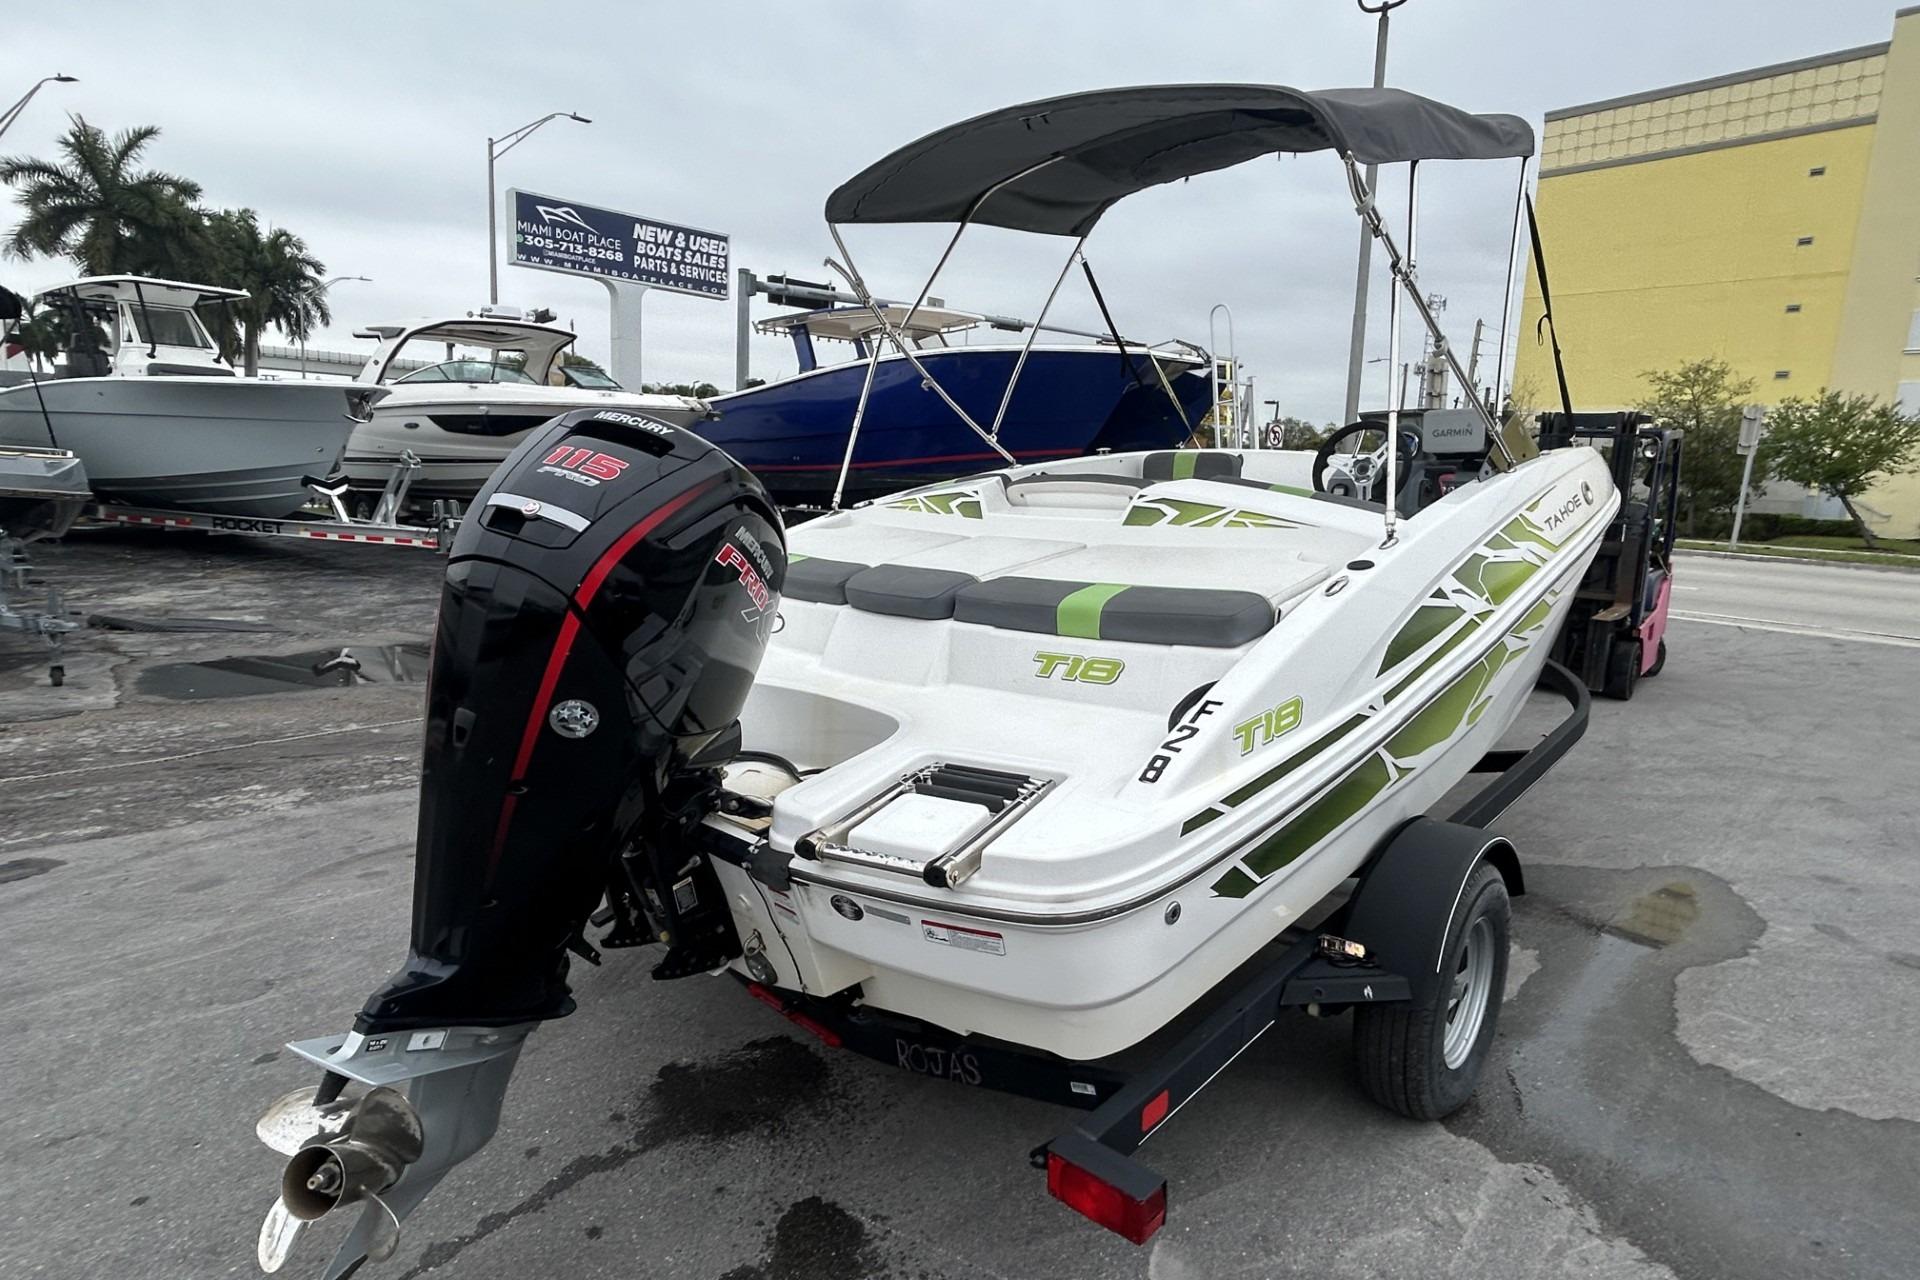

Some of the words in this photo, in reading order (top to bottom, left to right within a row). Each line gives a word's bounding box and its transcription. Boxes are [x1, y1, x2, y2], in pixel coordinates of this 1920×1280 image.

[517, 220, 552, 237] MIAMI
[555, 227, 584, 243] BOAT
[587, 234, 621, 250] PLACE
[524, 235, 624, 262] 305-713-8268
[633, 223, 673, 245] NEW
[675, 232, 686, 248] &
[689, 235, 728, 256] USED
[634, 255, 668, 273] PARTS
[670, 262, 677, 275] &
[679, 264, 728, 284] SERVICES
[636, 241, 682, 261] BOATS
[684, 250, 726, 269] SALES
[593, 411, 675, 435] MERCURY
[1432, 428, 1473, 438] GARMIN
[536, 466, 601, 487] PRO
[542, 446, 630, 481] 115
[212, 518, 285, 534] ROCKET
[1543, 494, 1583, 532] TAHOE
[715, 542, 769, 611] PRO
[1033, 650, 1125, 685] T18
[1233, 695, 1304, 756] T18
[896, 1039, 982, 1085] ROJAS
